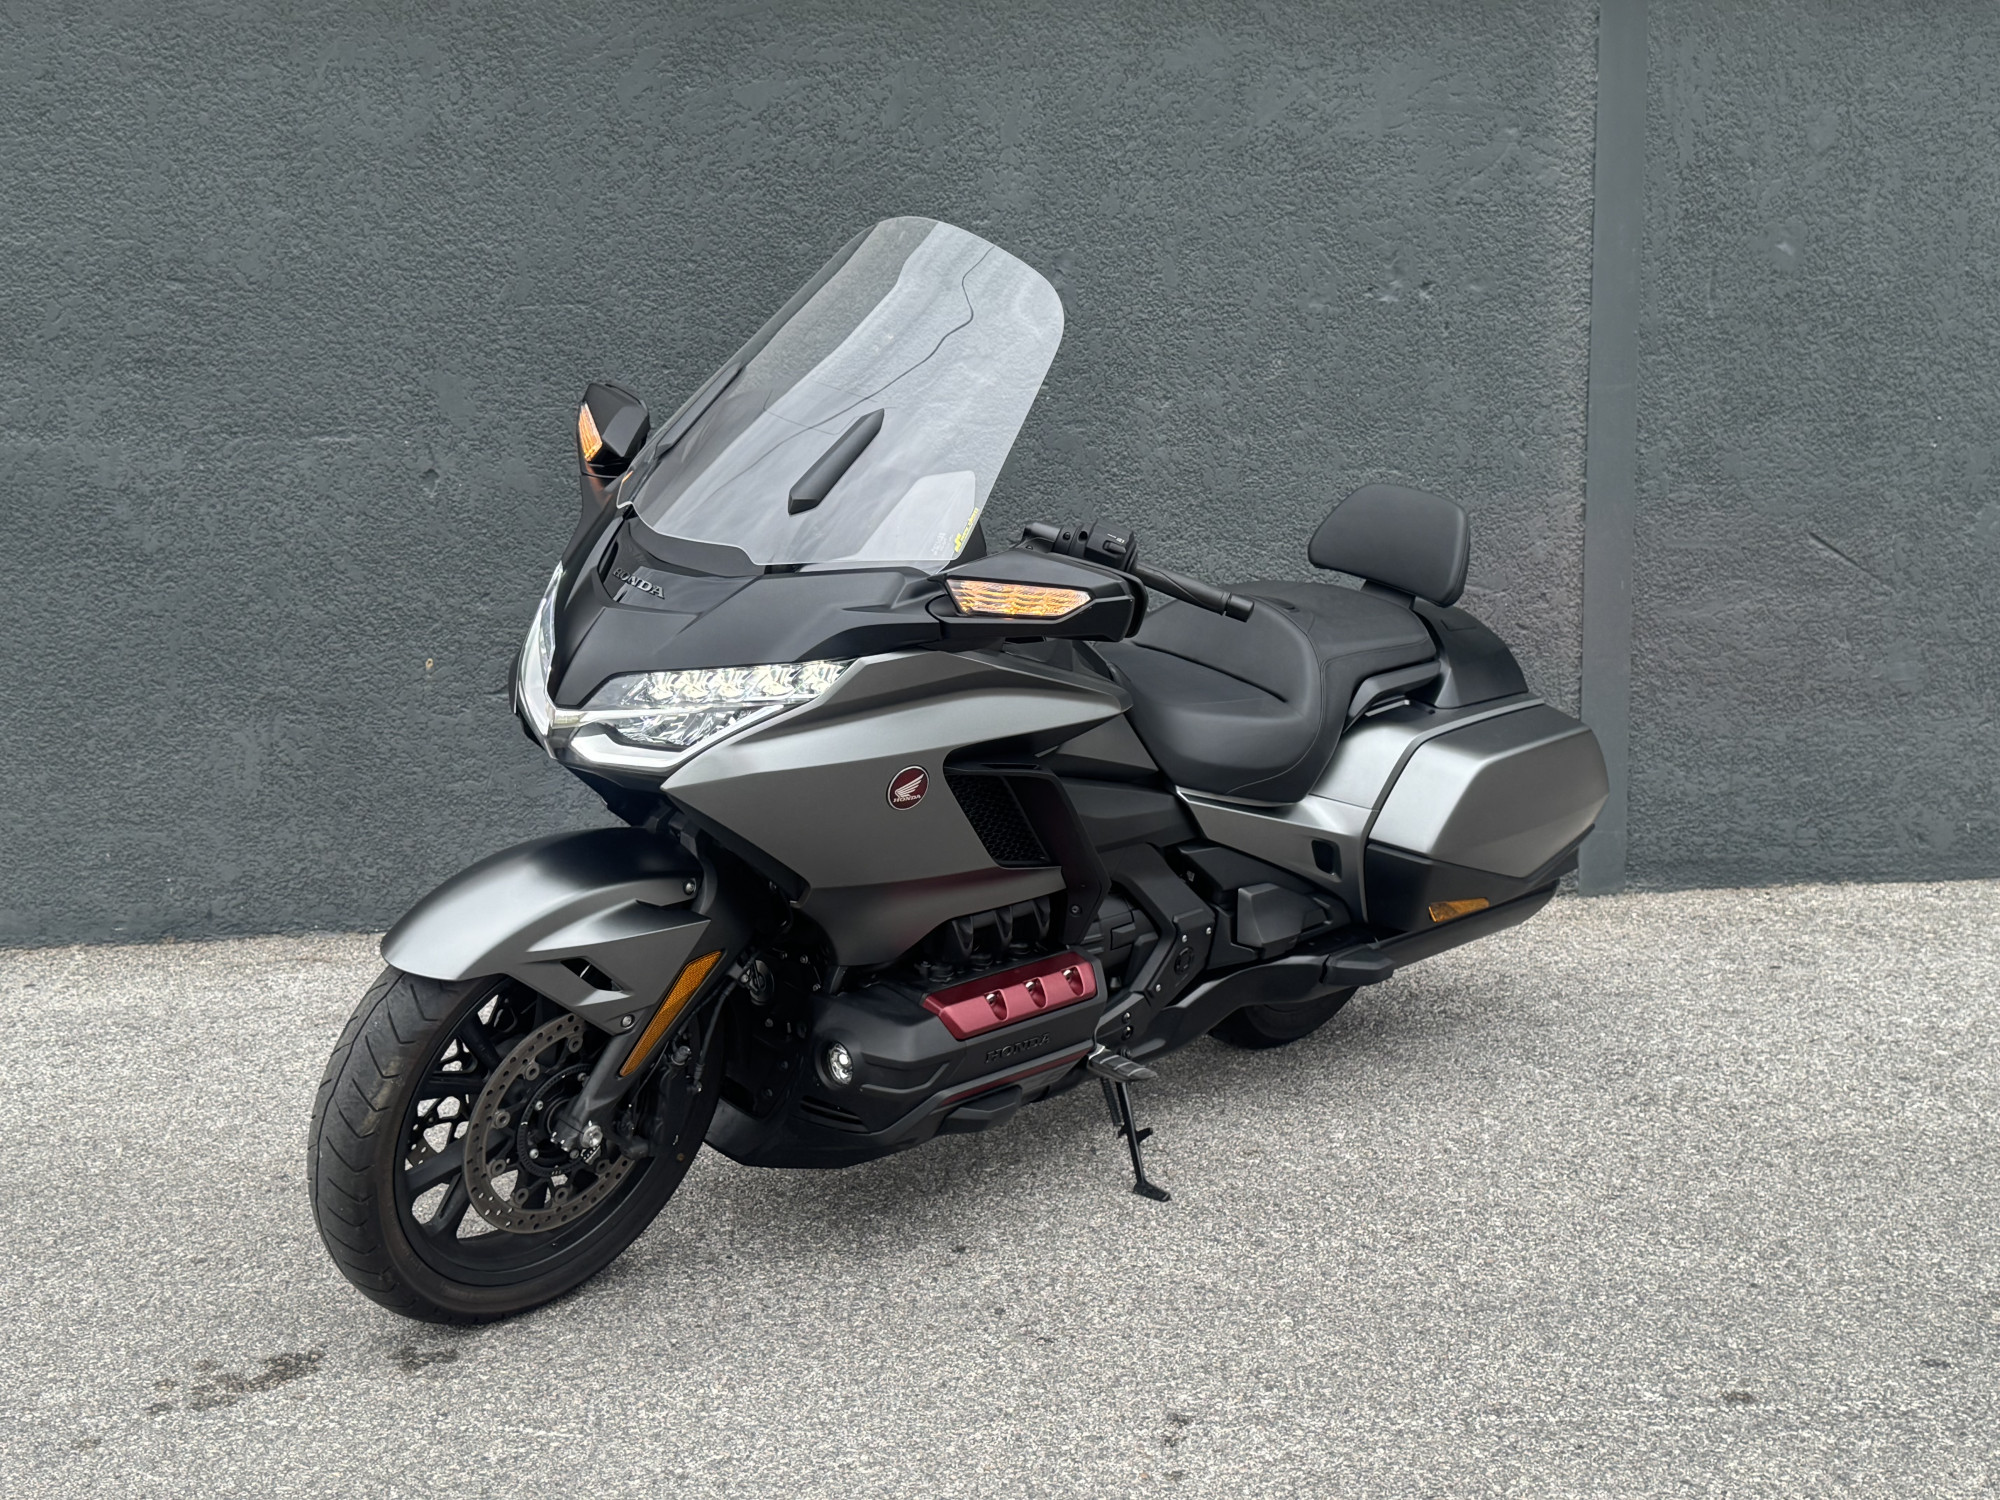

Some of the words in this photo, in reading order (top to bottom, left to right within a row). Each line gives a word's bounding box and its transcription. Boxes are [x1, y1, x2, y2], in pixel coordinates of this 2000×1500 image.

[612, 567, 665, 600] HONDA
[893, 794, 921, 803] HONDA
[985, 1032, 1051, 1063] HONDA
